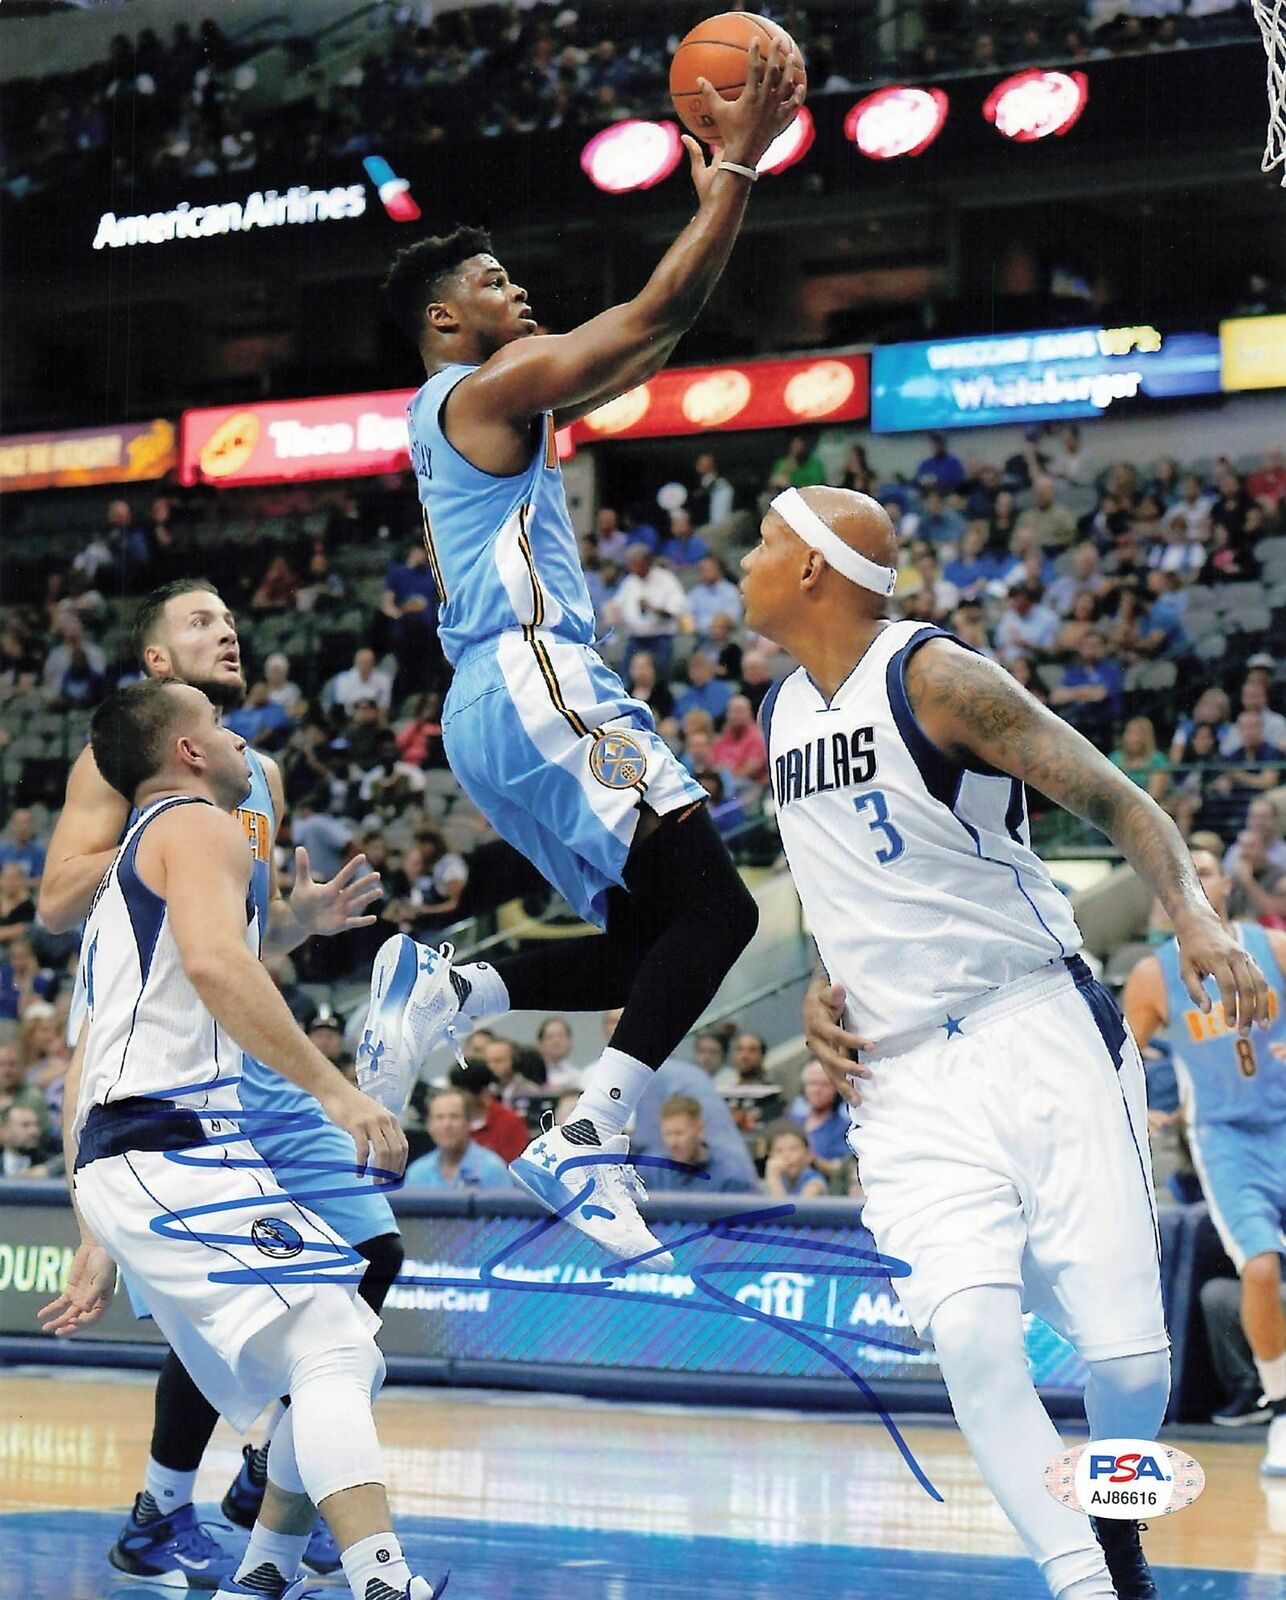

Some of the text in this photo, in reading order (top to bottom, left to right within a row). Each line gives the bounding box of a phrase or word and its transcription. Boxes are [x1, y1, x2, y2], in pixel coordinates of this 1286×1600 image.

[92, 186, 366, 250] American Airlines
[267, 420, 354, 459] Taco
[775, 725, 878, 809] DALLAS
[852, 789, 907, 867] 3
[1236, 1038, 1256, 1077] 8
[735, 1273, 812, 1321] citi
